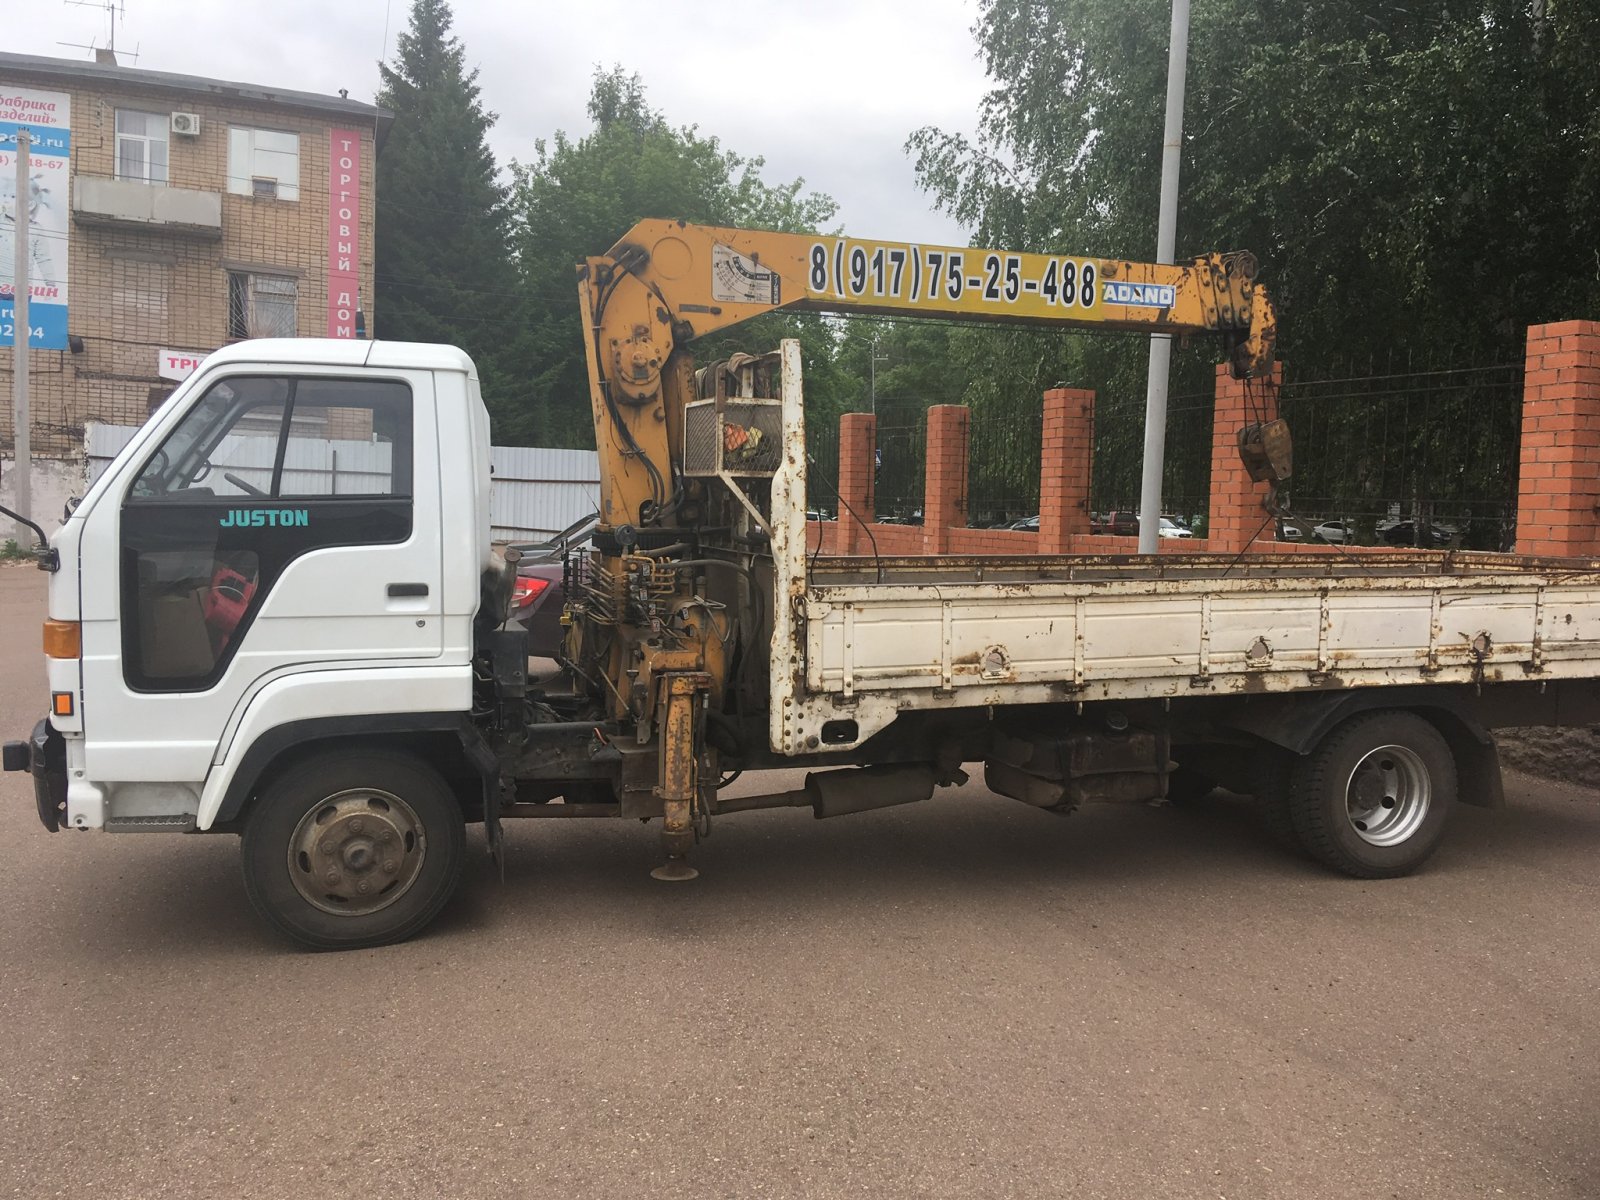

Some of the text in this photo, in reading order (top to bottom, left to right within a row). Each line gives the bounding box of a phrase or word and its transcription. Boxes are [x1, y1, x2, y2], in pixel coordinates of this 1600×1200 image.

[0, 108, 57, 124] зделий»
[337, 140, 353, 338] ТОРГОВЫЙ ДОМ
[810, 241, 1097, 308] 8(917)75-25-488
[1102, 284, 1173, 305] ADANO
[220, 510, 309, 527] JUSTON
